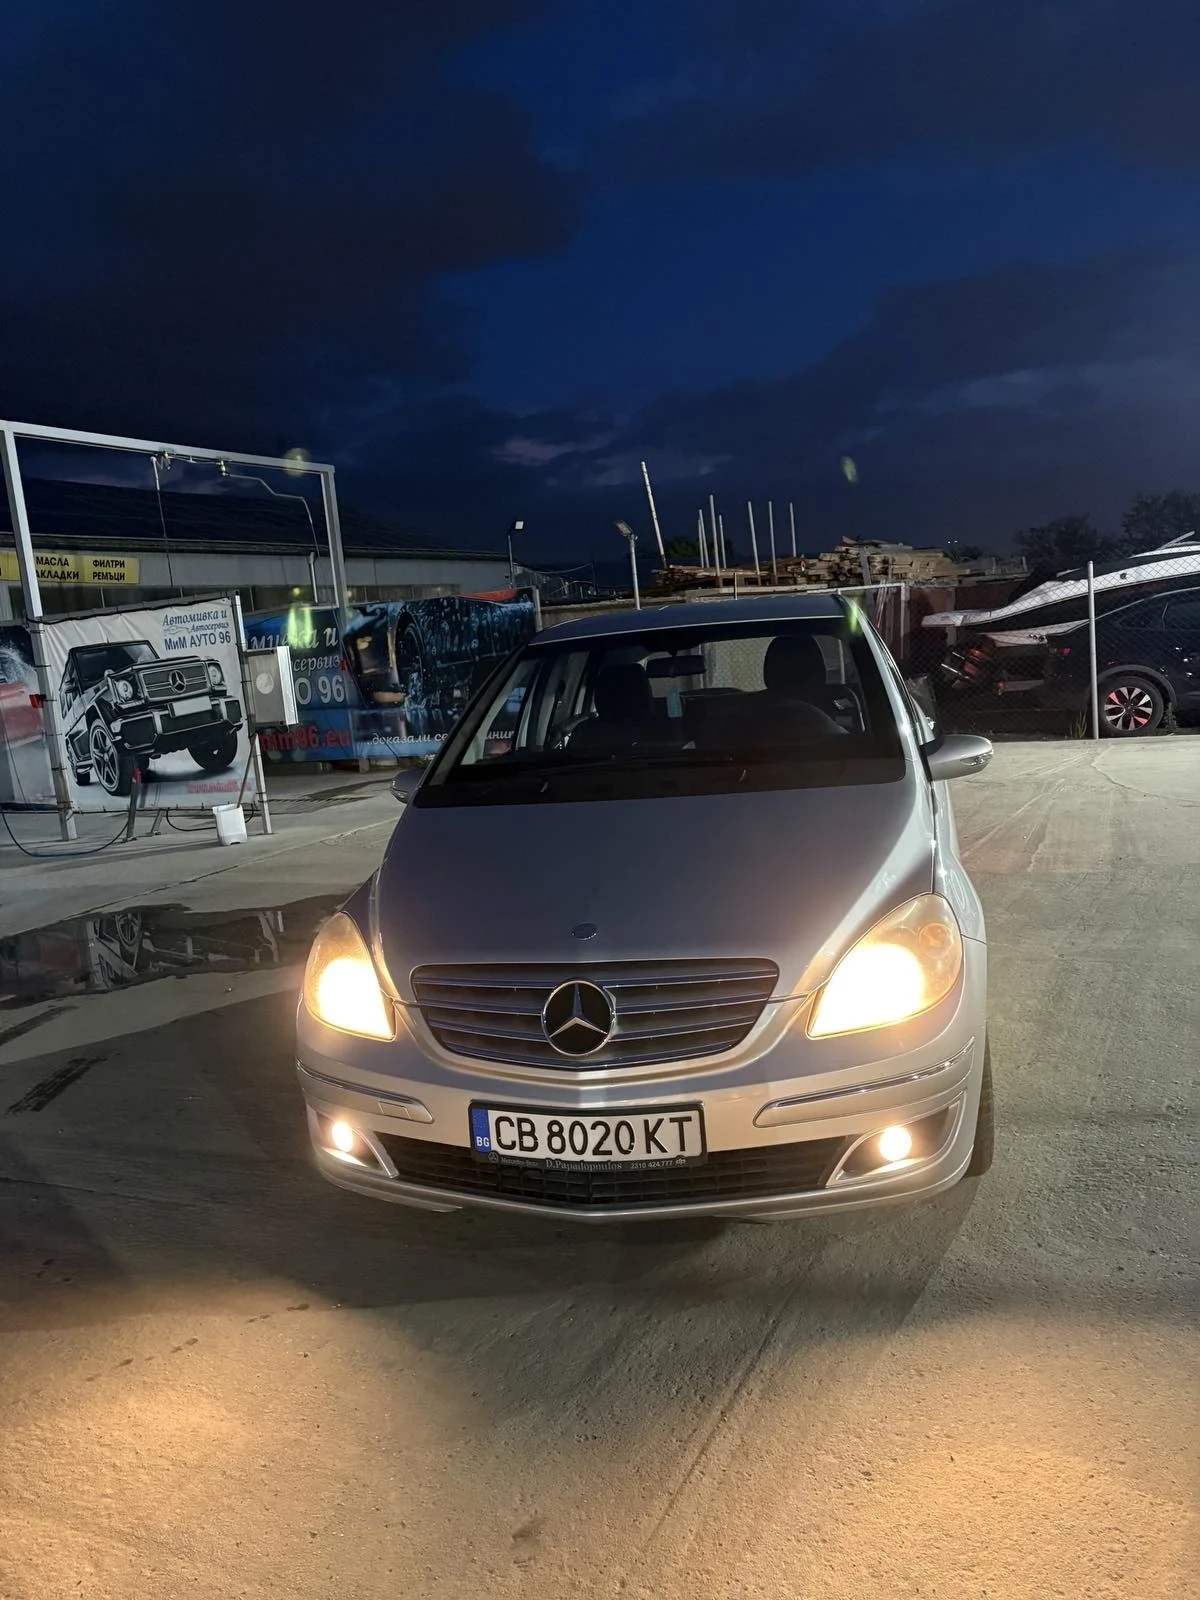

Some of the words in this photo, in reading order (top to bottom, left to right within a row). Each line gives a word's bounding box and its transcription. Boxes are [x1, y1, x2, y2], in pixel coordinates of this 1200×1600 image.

[36, 556, 70, 567] МАСЛА
[92, 560, 126, 569] ФИЛТРИ
[92, 571, 126, 582] РЕМЪЦИ
[162, 610, 219, 627] Автомивка
[221, 609, 228, 619] и
[190, 621, 230, 633] Автосервиз
[164, 636, 188, 651] МиМ
[190, 632, 217, 648] АУТО
[219, 630, 232, 644] 96
[318, 674, 346, 704] 96
[476, 1135, 490, 1148] BG
[495, 1116, 539, 1152] CB
[547, 1119, 635, 1156] 8020
[644, 1116, 692, 1153] KT
